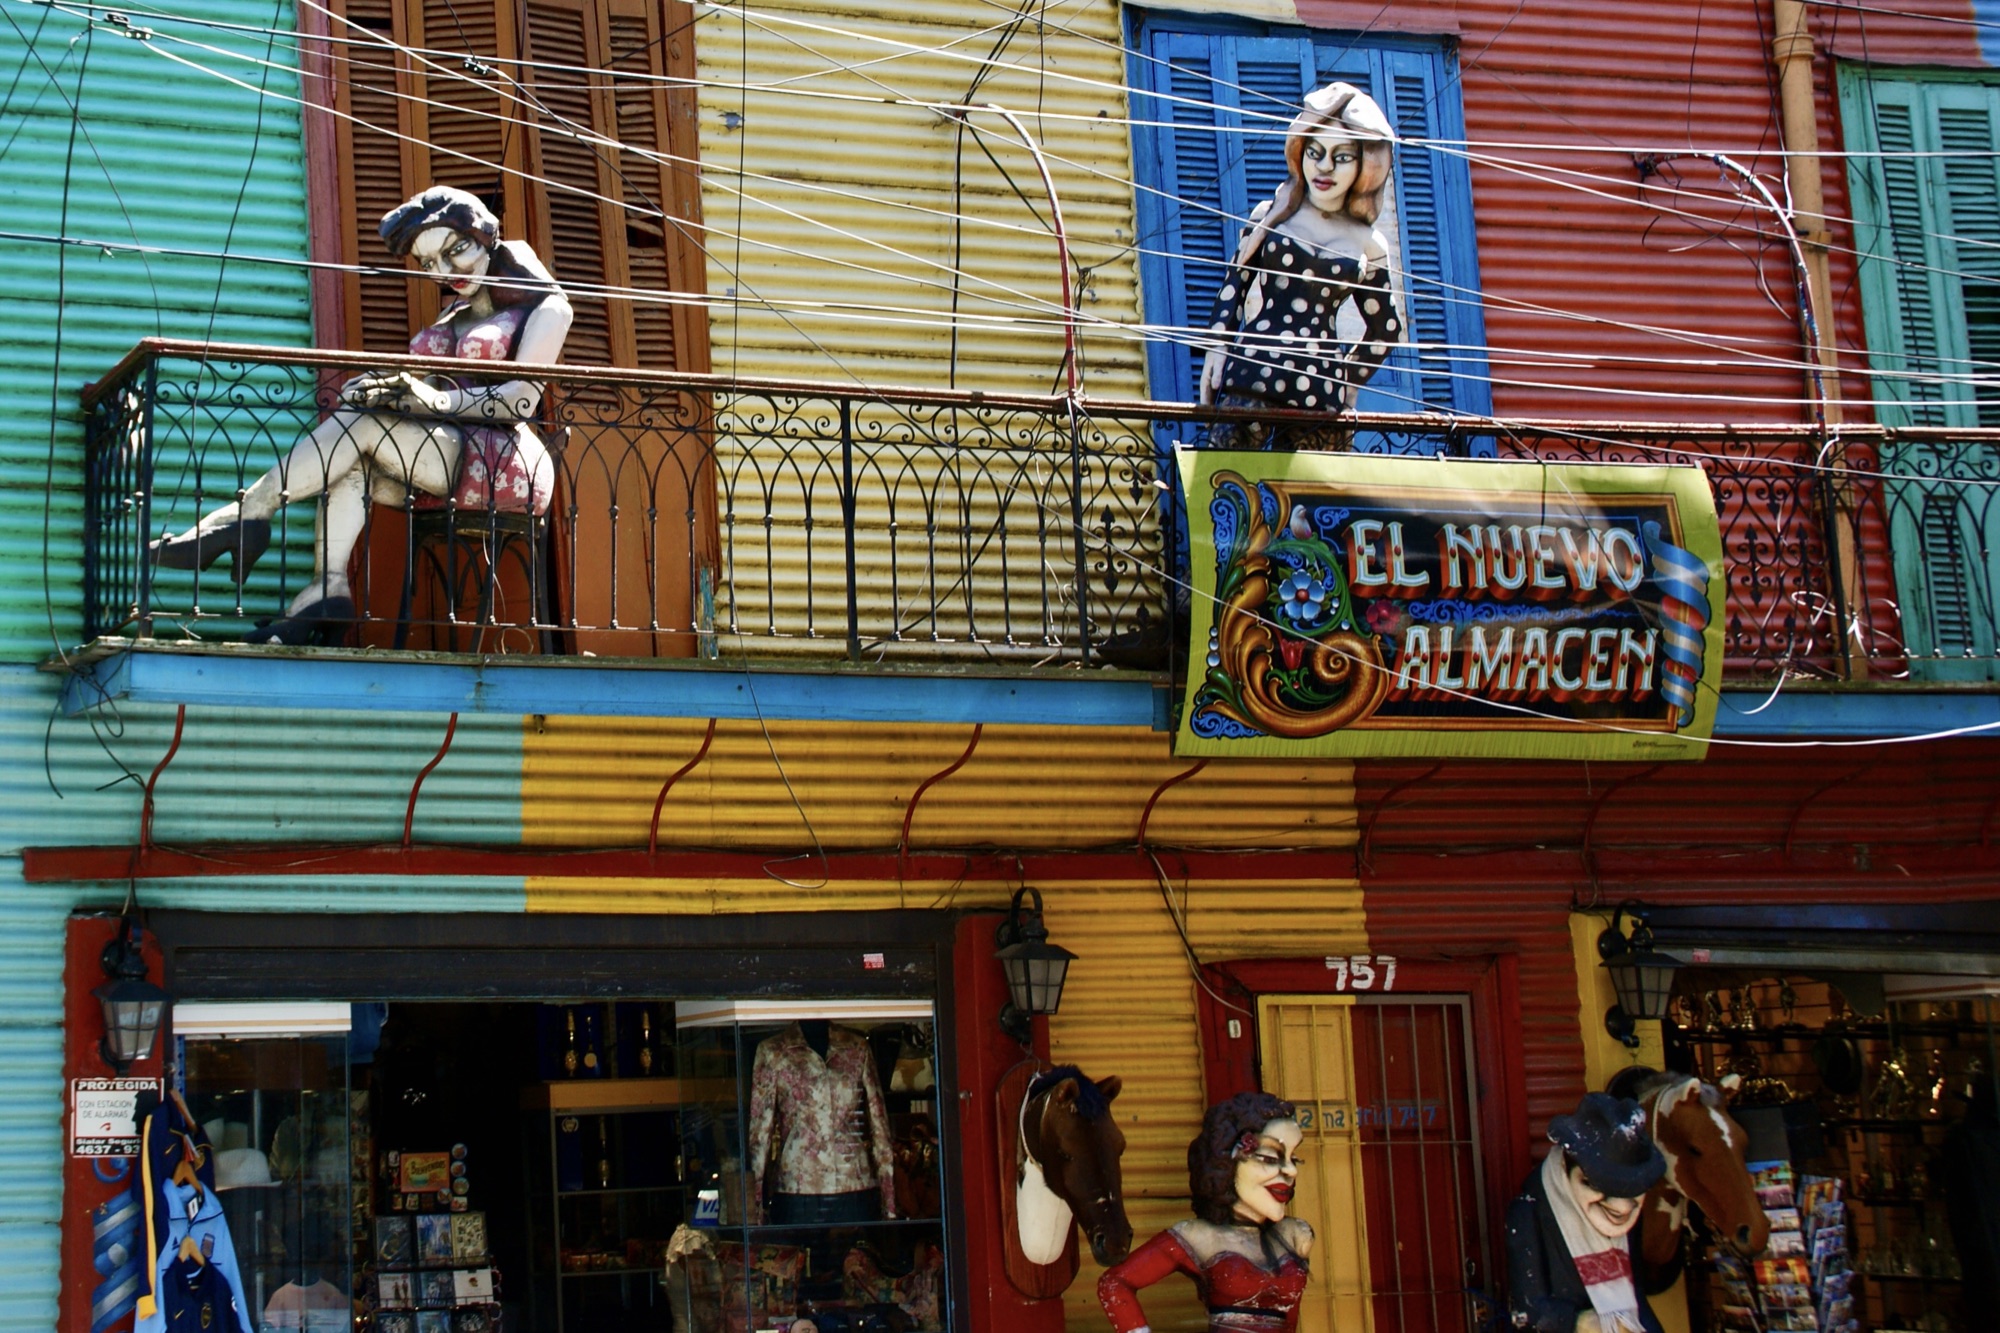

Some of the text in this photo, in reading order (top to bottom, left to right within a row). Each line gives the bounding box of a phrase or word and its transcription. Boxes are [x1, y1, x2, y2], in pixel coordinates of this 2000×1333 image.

[1345, 519, 1644, 598] EL NUEVO
[1391, 625, 1657, 699] ALMACEN
[1325, 955, 1397, 991] 757
[78, 1081, 158, 1090] PROTEGIDA
[79, 1100, 94, 1108] CON
[83, 1110, 128, 1118] DE ALARMAS
[108, 1138, 141, 1146] Seguri
[76, 1145, 111, 1154] 4637
[123, 1145, 140, 1154] 93
